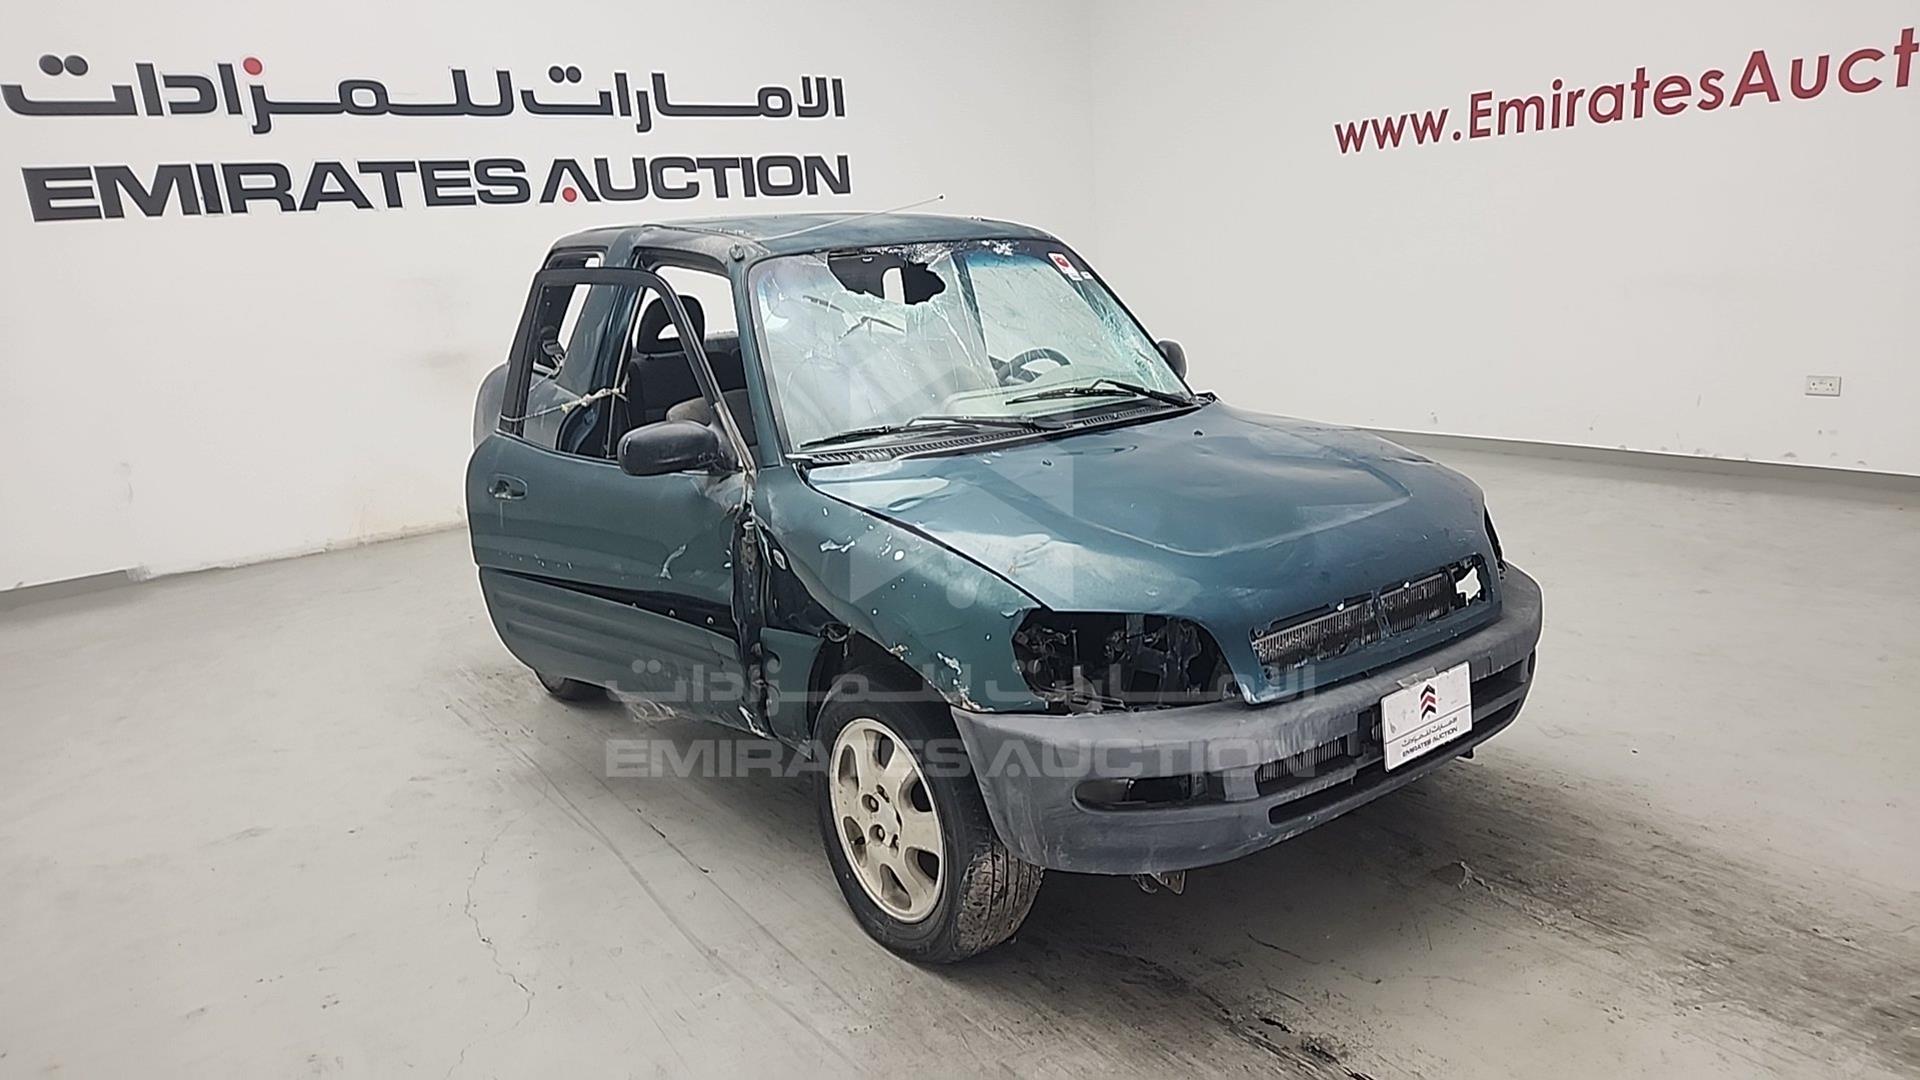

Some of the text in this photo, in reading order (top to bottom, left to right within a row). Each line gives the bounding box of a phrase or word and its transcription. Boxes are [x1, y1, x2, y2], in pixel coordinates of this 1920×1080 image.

[0, 55, 516, 136] للمزادات
[1334, 27, 1919, 154] www.EmiratesAuct
[21, 155, 851, 223] EMIRATES AUCTION
